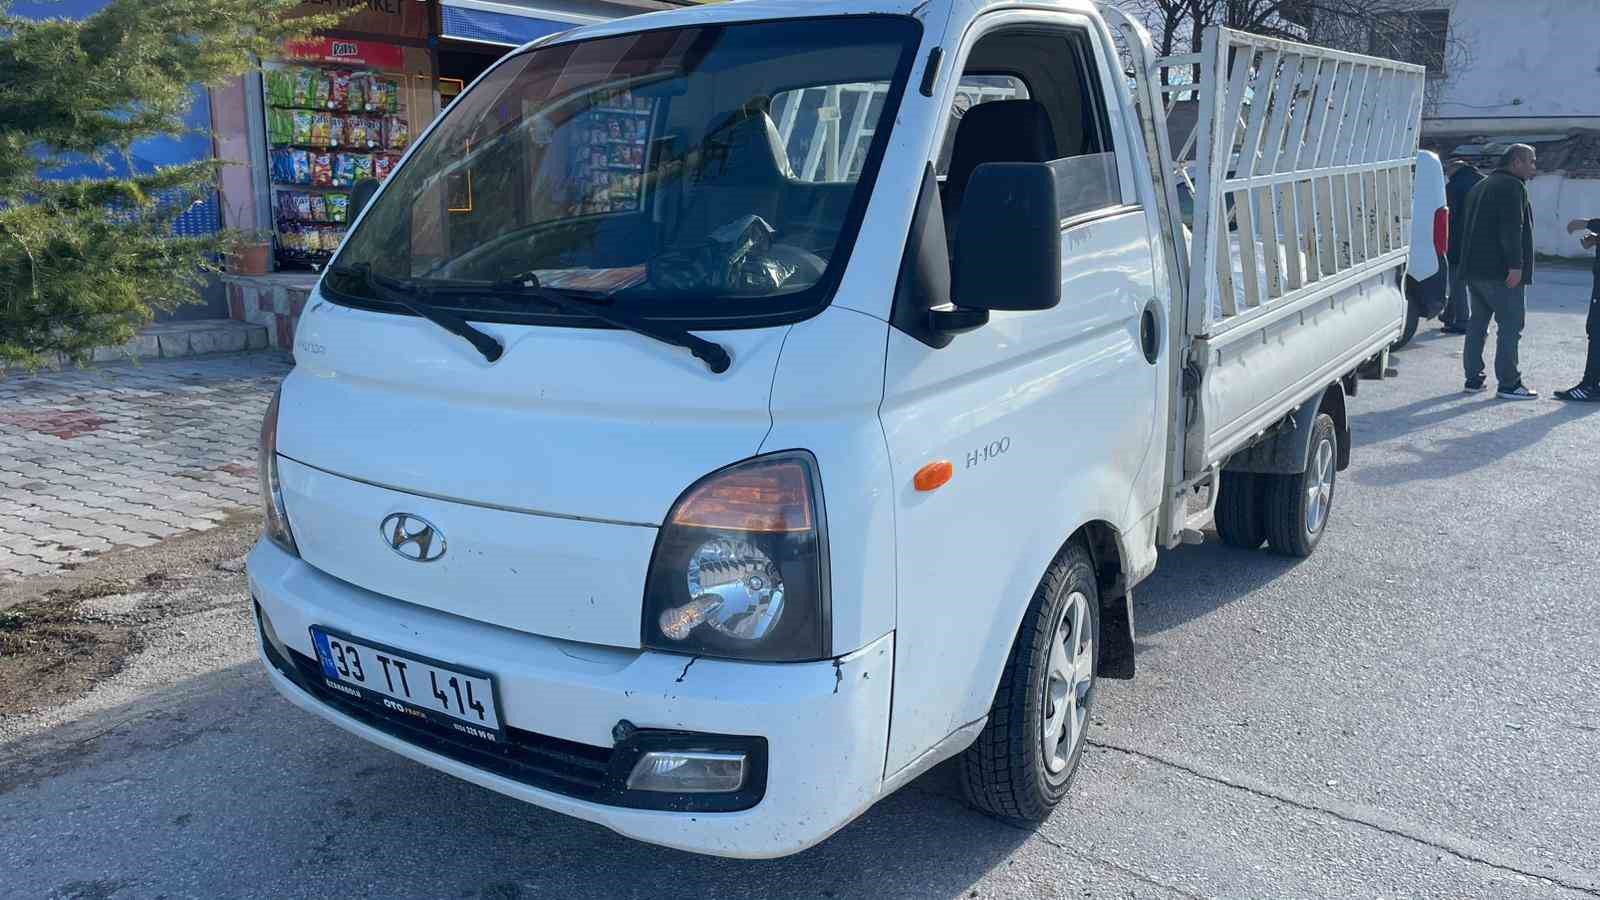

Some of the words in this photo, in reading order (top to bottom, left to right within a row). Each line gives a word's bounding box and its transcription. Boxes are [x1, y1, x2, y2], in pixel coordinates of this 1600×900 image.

[966, 436, 1010, 469] H-100
[331, 641, 365, 682] 33
[376, 655, 410, 698] TT
[430, 671, 485, 720] 414
